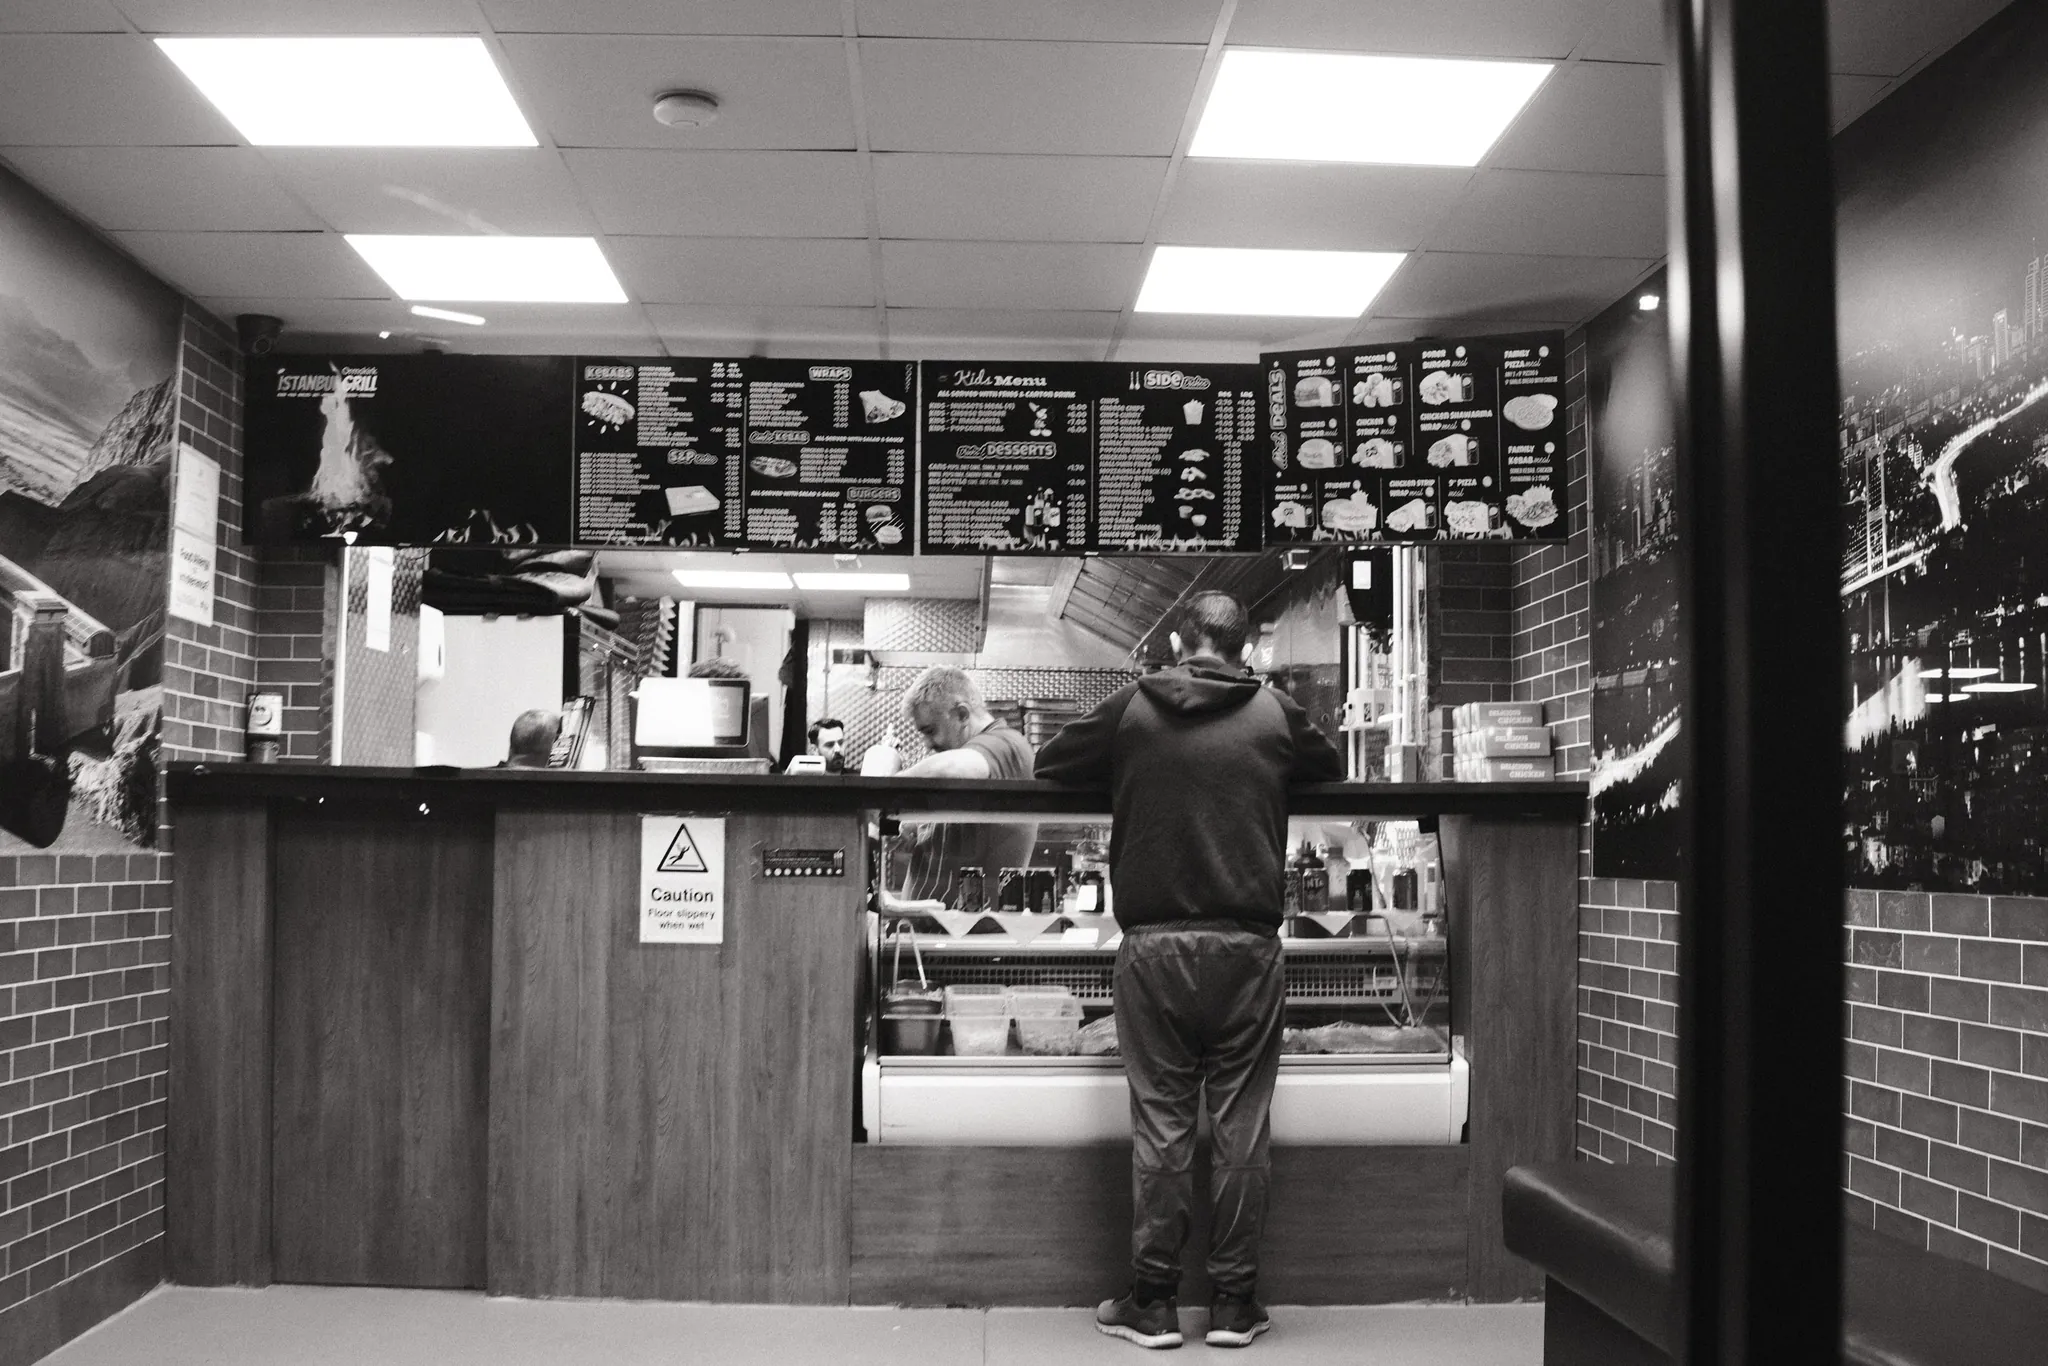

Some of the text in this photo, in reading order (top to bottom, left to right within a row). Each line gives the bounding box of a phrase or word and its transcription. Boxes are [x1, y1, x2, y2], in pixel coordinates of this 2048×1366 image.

[954, 368, 1047, 387] Kids Menu
[1498, 716, 1533, 724] CHICKEN
[1504, 742, 1541, 750] CHICKEN
[1509, 770, 1545, 779] CHICKEN
[652, 887, 714, 902] Caution
[660, 920, 704, 929] when wet
